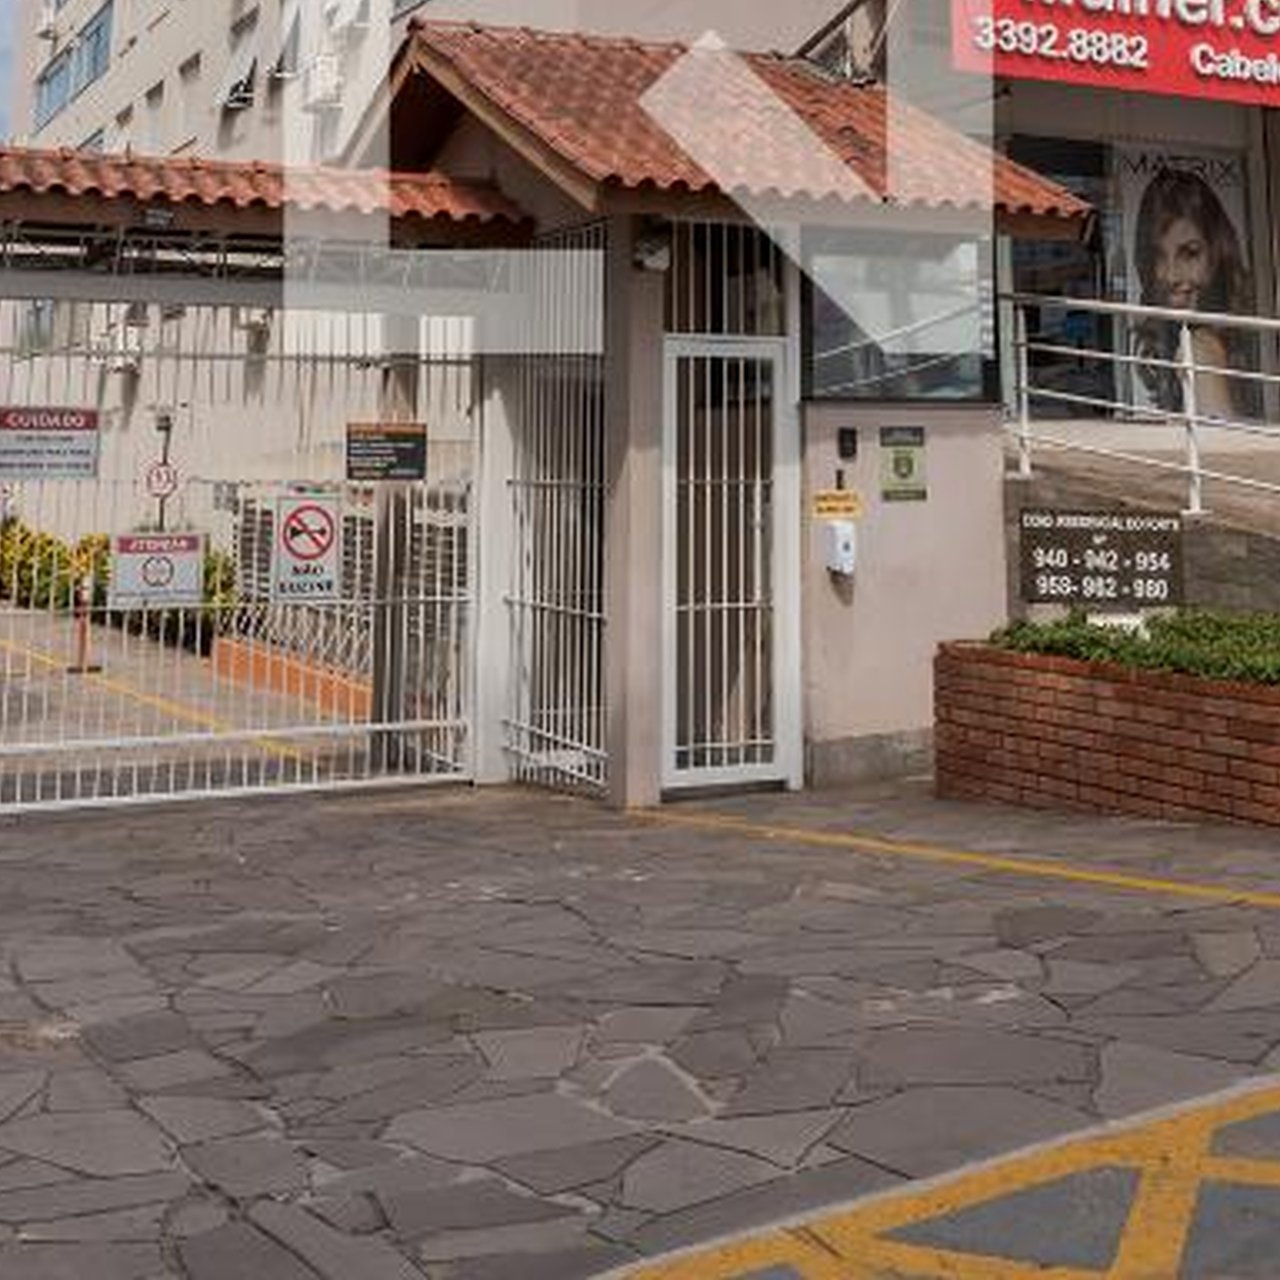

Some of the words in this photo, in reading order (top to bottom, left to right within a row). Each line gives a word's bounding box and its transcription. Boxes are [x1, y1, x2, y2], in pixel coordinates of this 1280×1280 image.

[972, 16, 1149, 69] 3392.8882
[4, 411, 87, 429] CUIDADO
[1032, 547, 1068, 568] 940
[1135, 551, 1172, 570] 954
